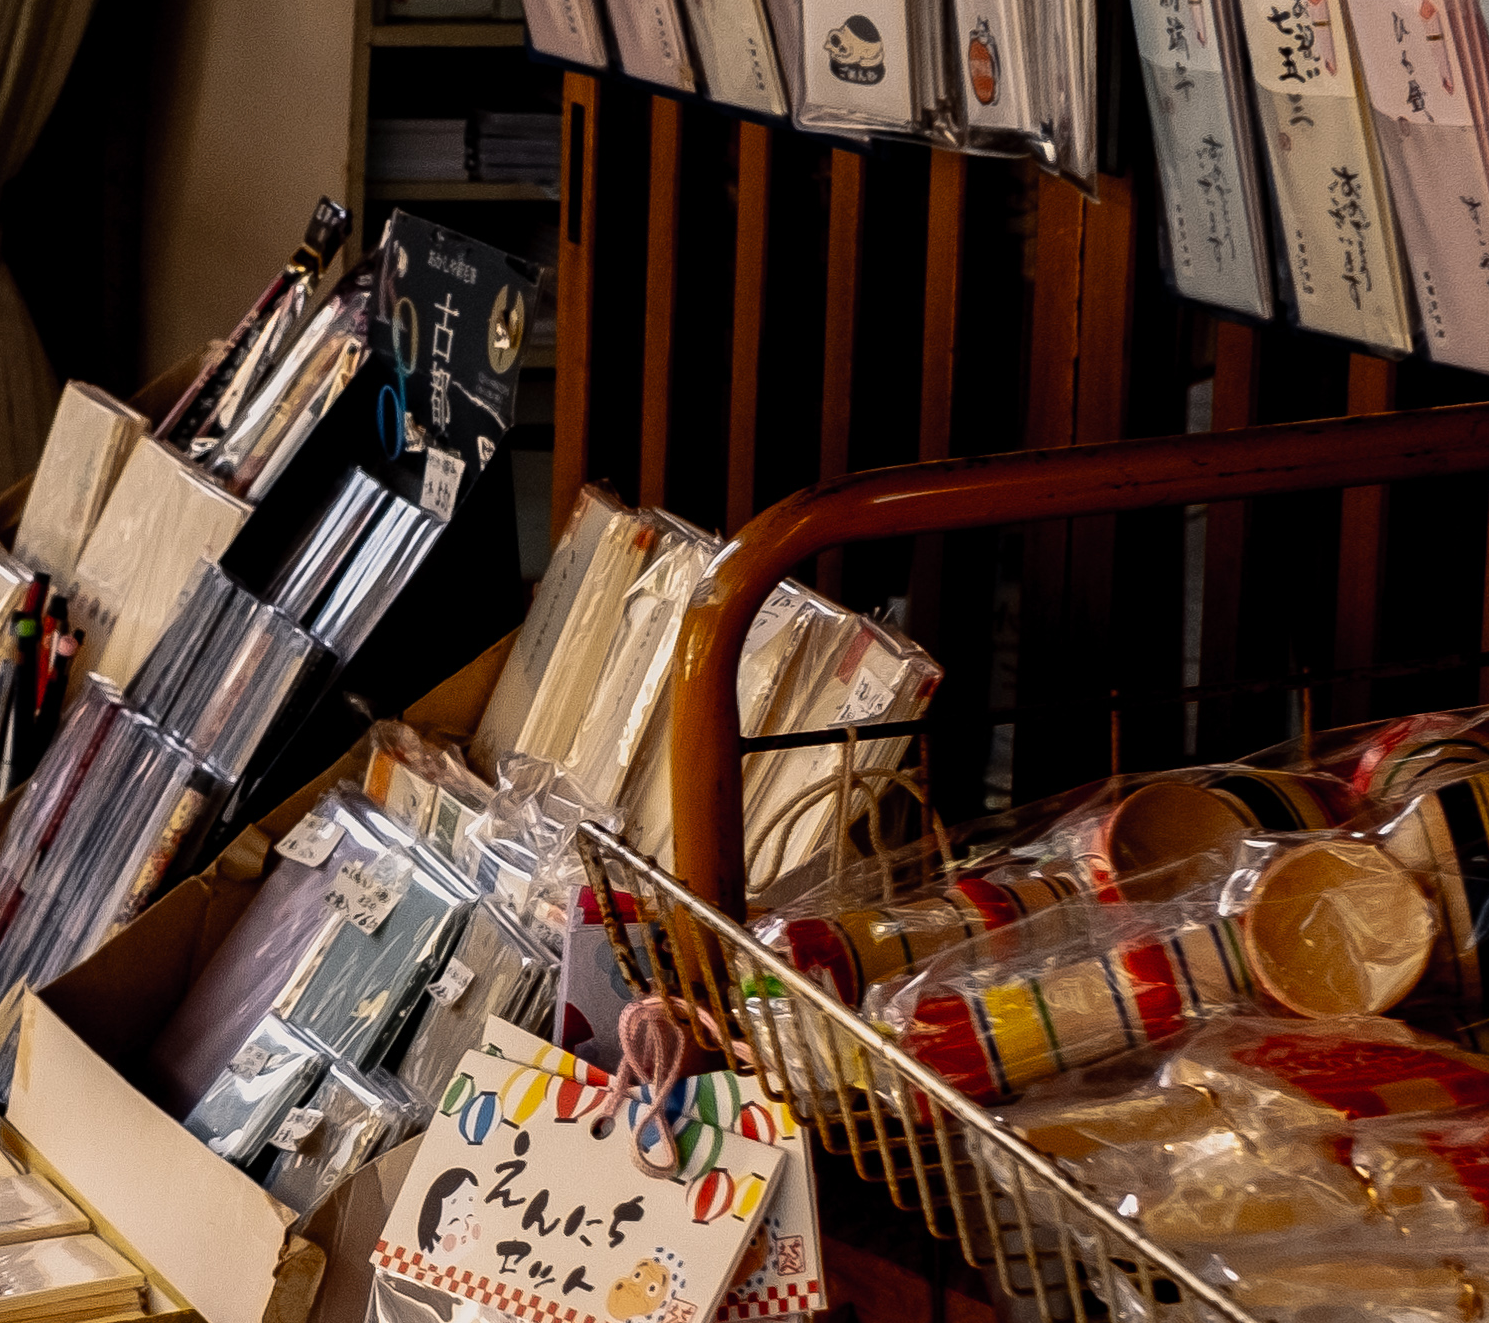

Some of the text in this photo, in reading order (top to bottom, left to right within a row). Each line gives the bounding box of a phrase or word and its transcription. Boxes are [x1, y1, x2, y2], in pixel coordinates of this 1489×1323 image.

[1267, 6, 1316, 128] 七五三
[431, 292, 461, 434] 古都
[484, 1130, 646, 1249] えんにち
[495, 1239, 596, 1296] セット
